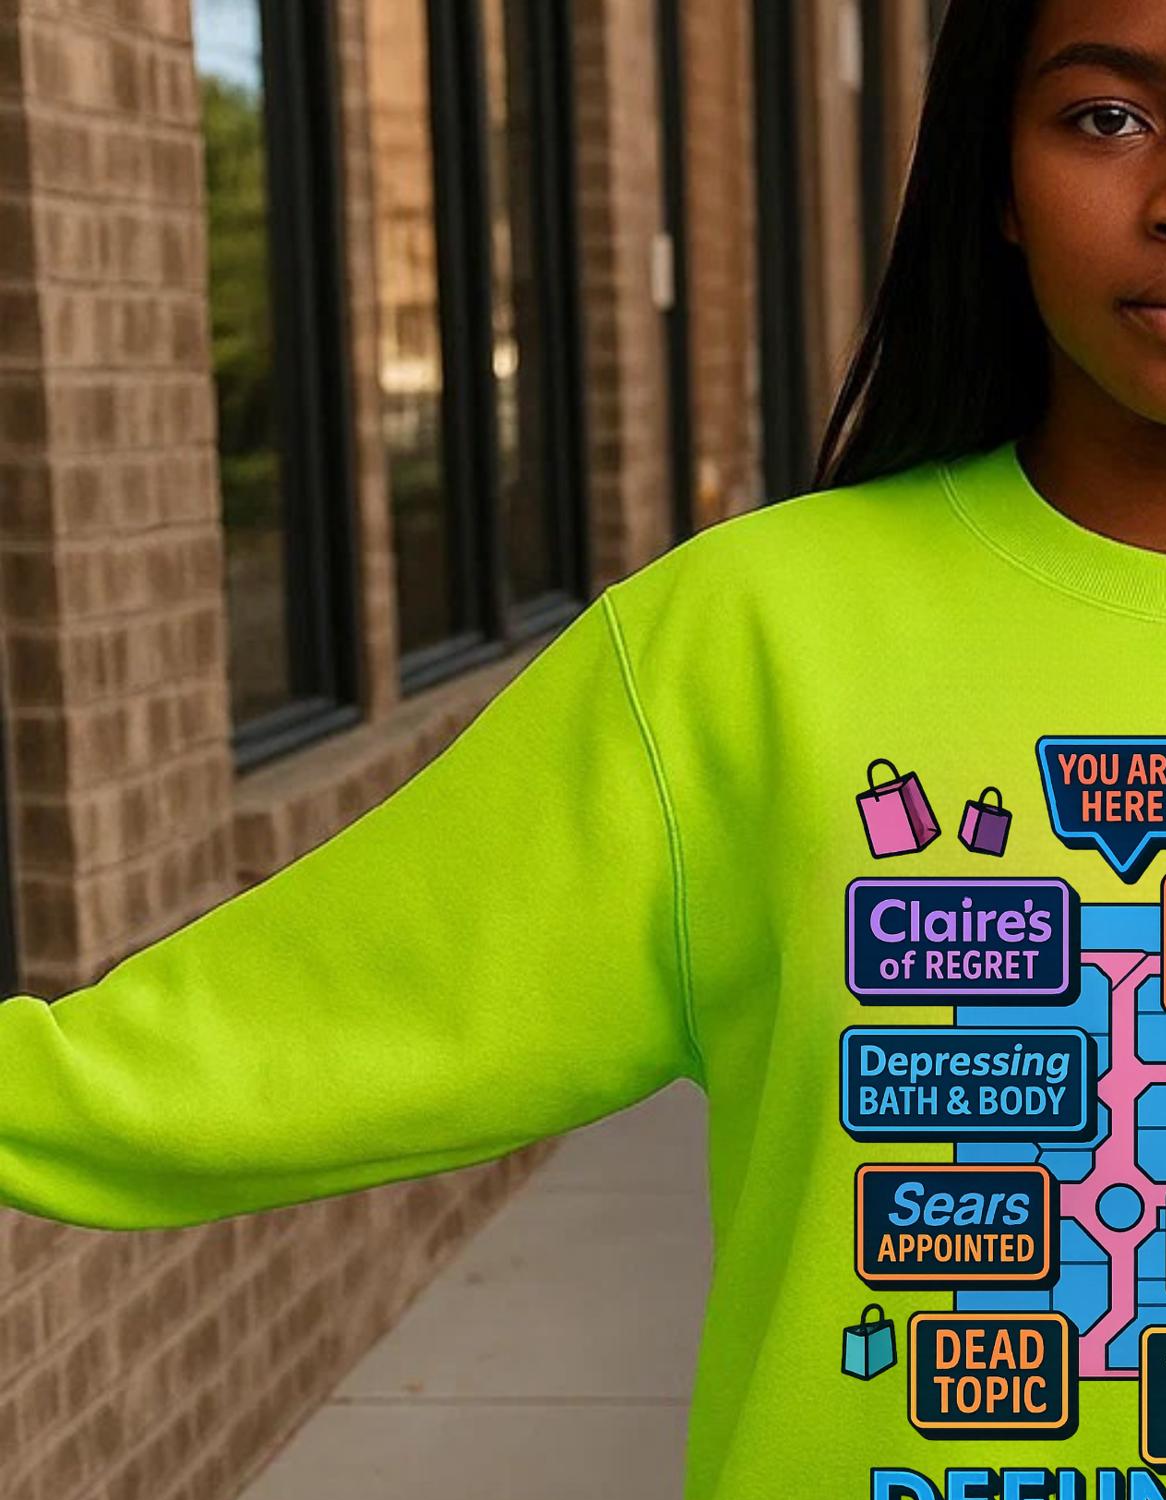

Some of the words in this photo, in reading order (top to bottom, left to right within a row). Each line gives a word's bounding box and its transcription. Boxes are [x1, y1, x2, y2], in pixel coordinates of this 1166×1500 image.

[1057, 752, 1119, 786] YOU
[1081, 790, 1164, 823] HERE
[869, 896, 1053, 943] Claire's
[879, 950, 916, 980] of
[925, 950, 1040, 980] REGRET
[860, 1043, 1070, 1083] Depressing
[859, 1085, 938, 1116] BATH
[947, 1085, 972, 1116] &
[979, 1085, 1067, 1116] BODY
[888, 1181, 1031, 1227] Sears
[877, 1233, 1035, 1263] APPOINTED
[935, 1328, 1046, 1371] DEAD
[933, 1375, 1047, 1414] TOPIC
